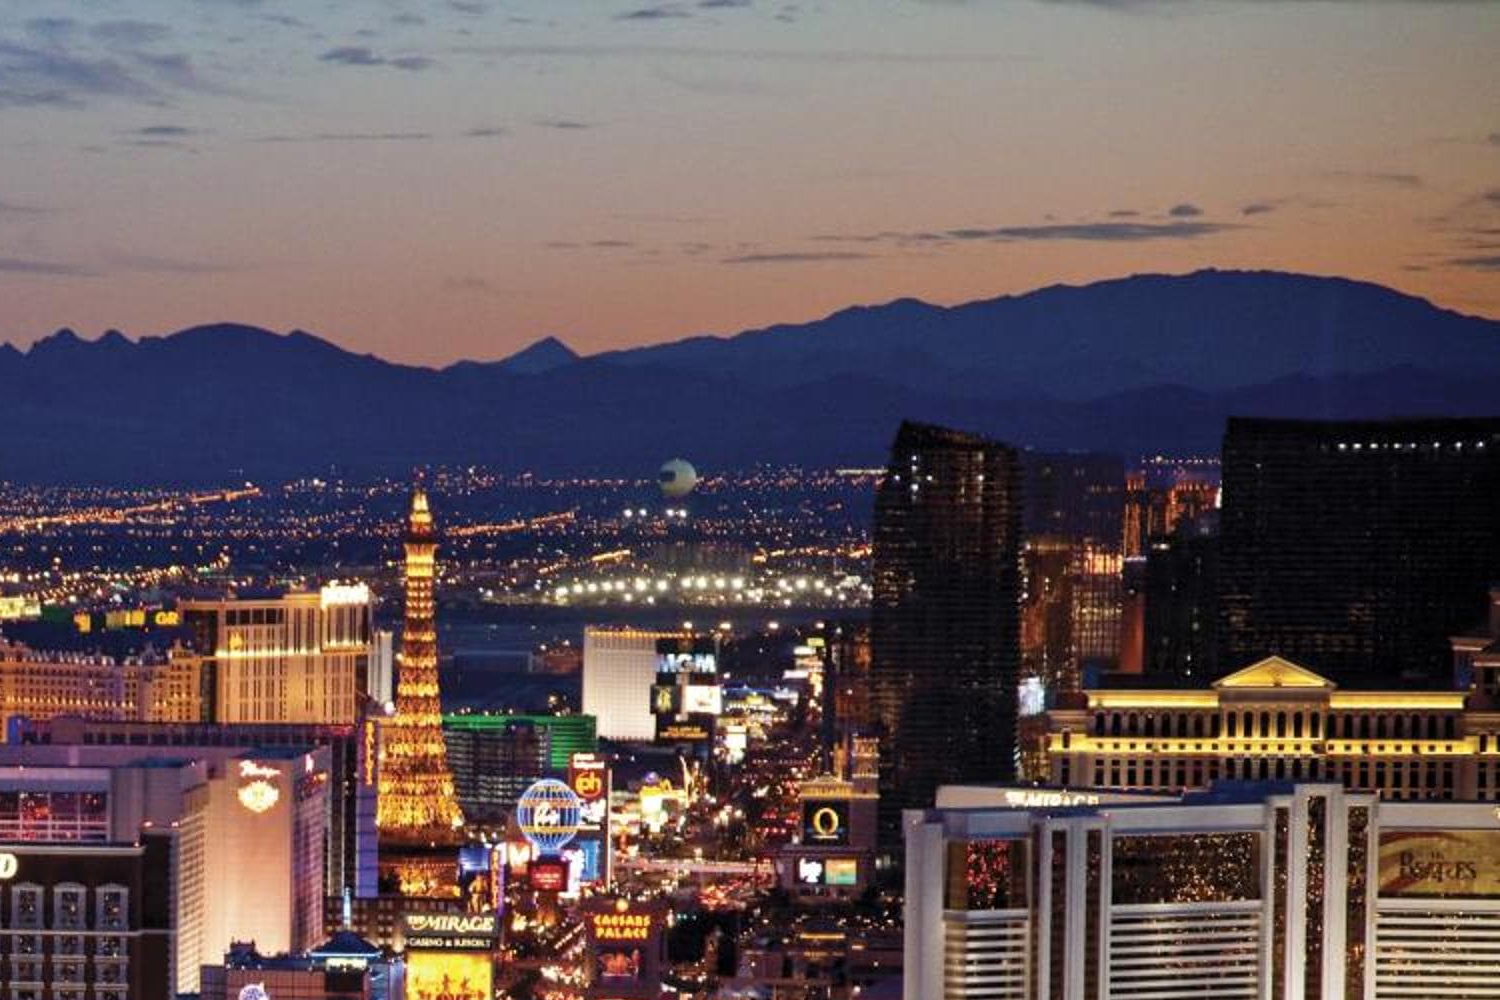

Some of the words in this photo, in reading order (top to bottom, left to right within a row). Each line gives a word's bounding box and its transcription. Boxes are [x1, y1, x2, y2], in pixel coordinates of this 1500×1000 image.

[427, 915, 495, 932] MIRAGE
[593, 914, 651, 927] CAESARS
[596, 927, 648, 939] PALACE
